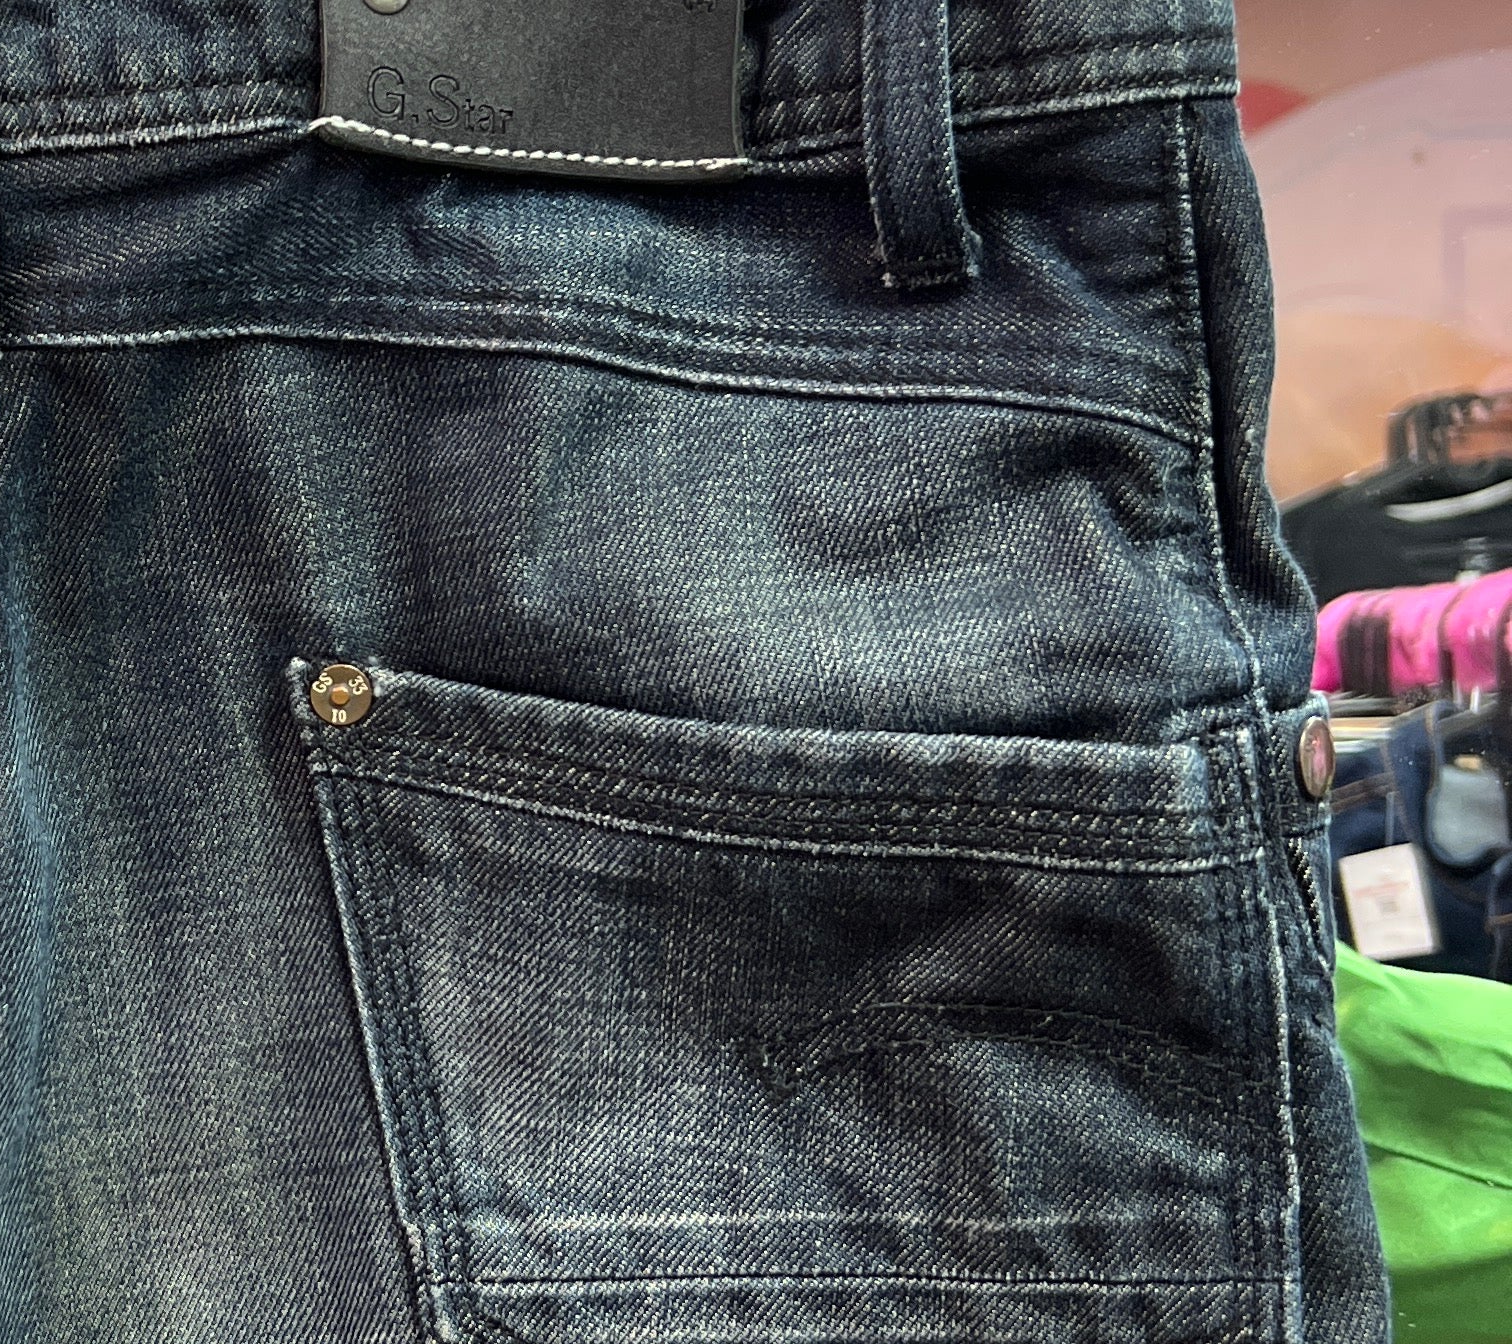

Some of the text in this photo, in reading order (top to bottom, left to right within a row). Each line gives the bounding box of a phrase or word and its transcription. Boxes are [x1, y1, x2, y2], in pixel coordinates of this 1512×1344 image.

[311, 672, 334, 694] GS
[348, 675, 369, 696] 33
[331, 708, 347, 723] 10
